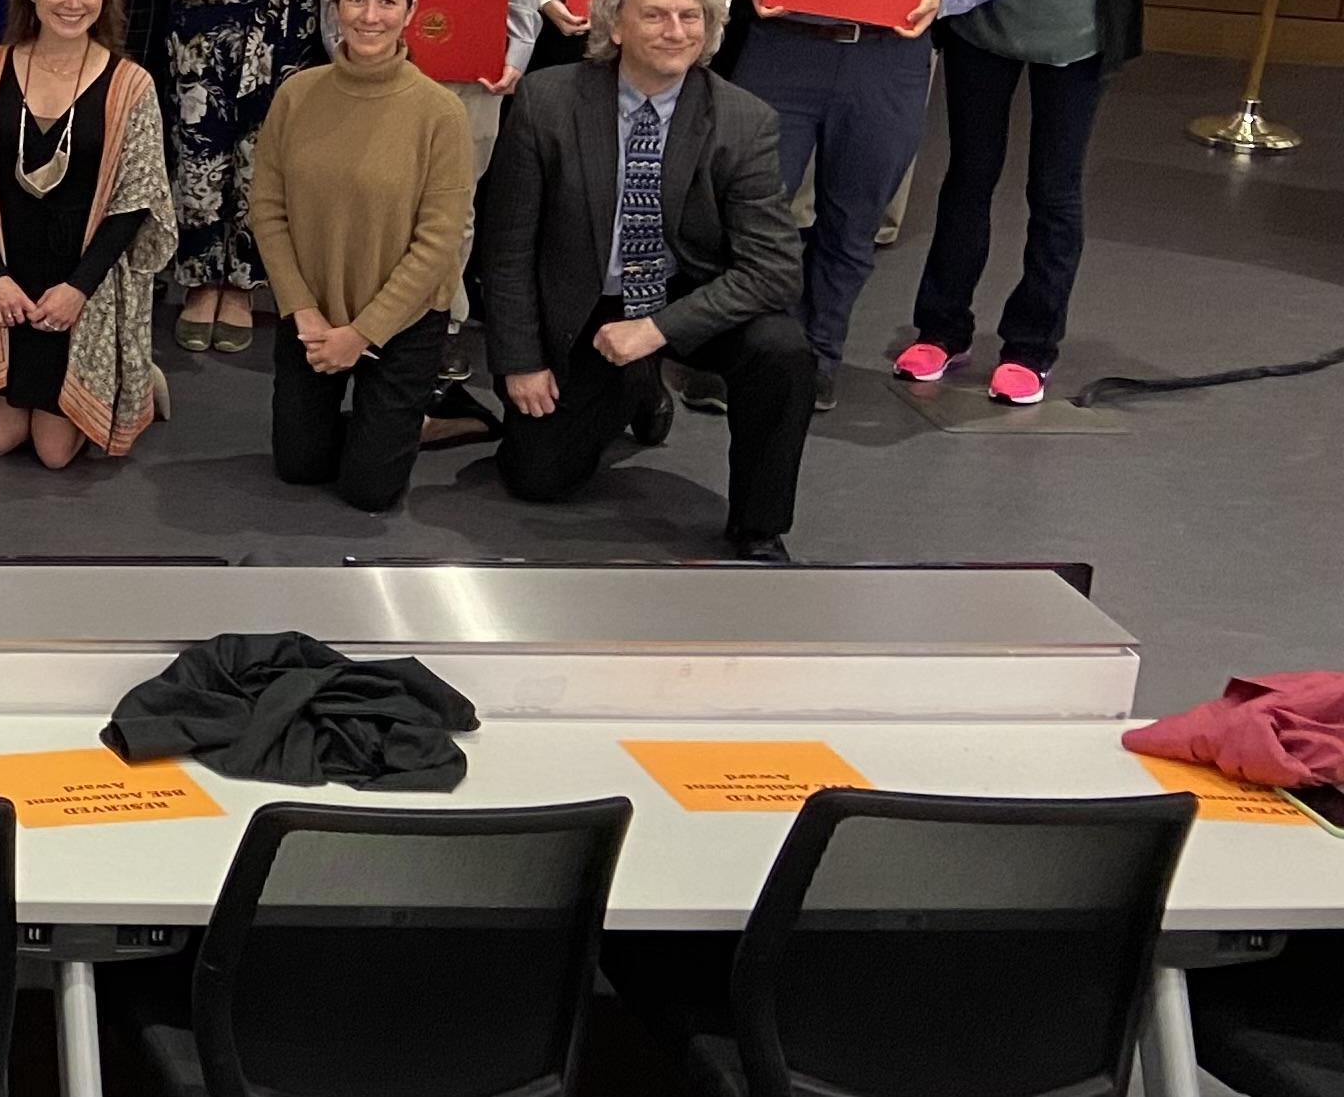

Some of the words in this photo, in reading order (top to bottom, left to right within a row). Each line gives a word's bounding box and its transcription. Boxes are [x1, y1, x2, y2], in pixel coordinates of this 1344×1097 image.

[723, 773, 791, 782] Award
[62, 781, 126, 793] Award
[683, 783, 810, 792] Achievement
[146, 789, 187, 798] BSE
[23, 791, 143, 807] Achievement
[63, 800, 171, 816] RESERVED
